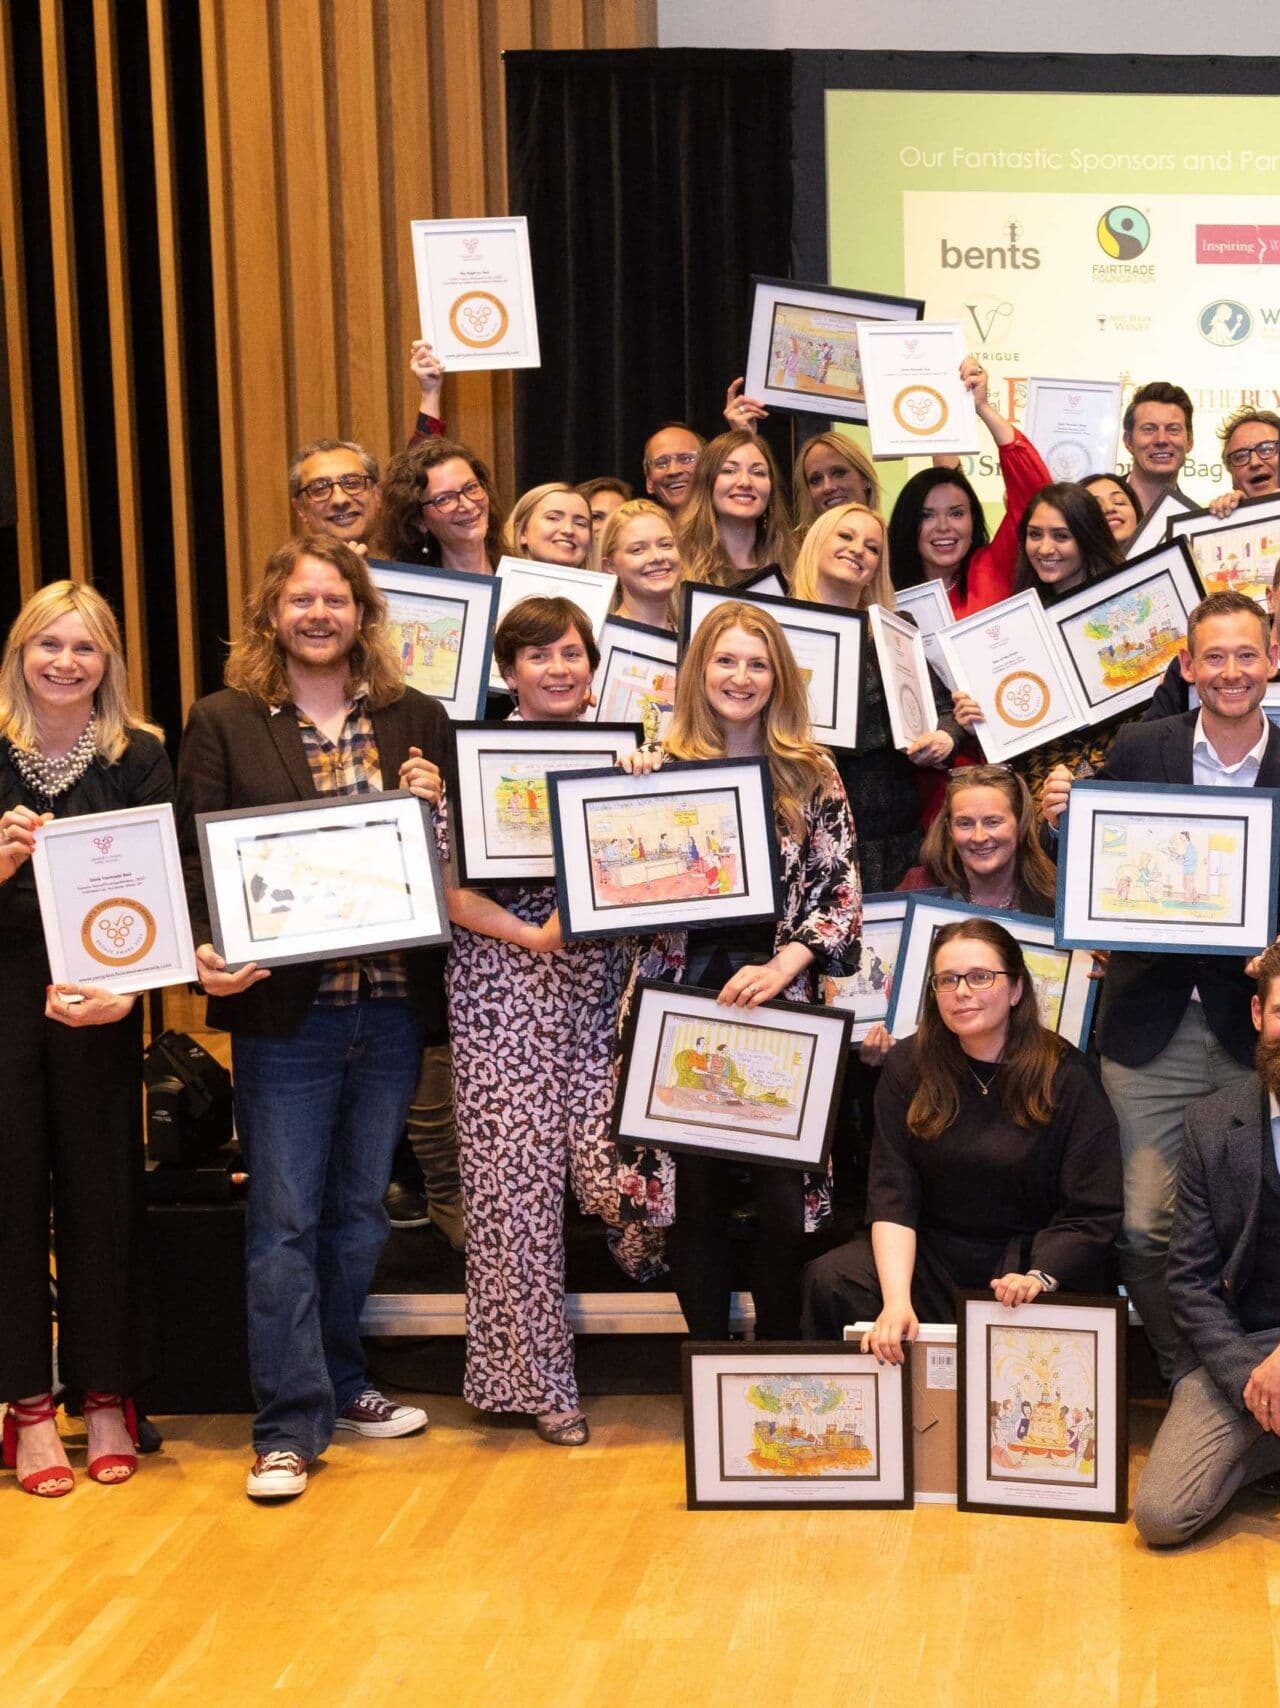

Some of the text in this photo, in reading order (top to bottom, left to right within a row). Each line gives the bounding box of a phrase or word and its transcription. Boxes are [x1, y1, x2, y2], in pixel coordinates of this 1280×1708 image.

[900, 147, 944, 168] Our
[953, 147, 1062, 169] Fantastic
[1072, 149, 1175, 174] Sponsors
[1184, 149, 1231, 171] and
[941, 234, 1040, 269] bents
[1202, 239, 1255, 254] Inspiring
[1092, 264, 1156, 275] FAIRTRADE
[1184, 459, 1222, 482] Bag
